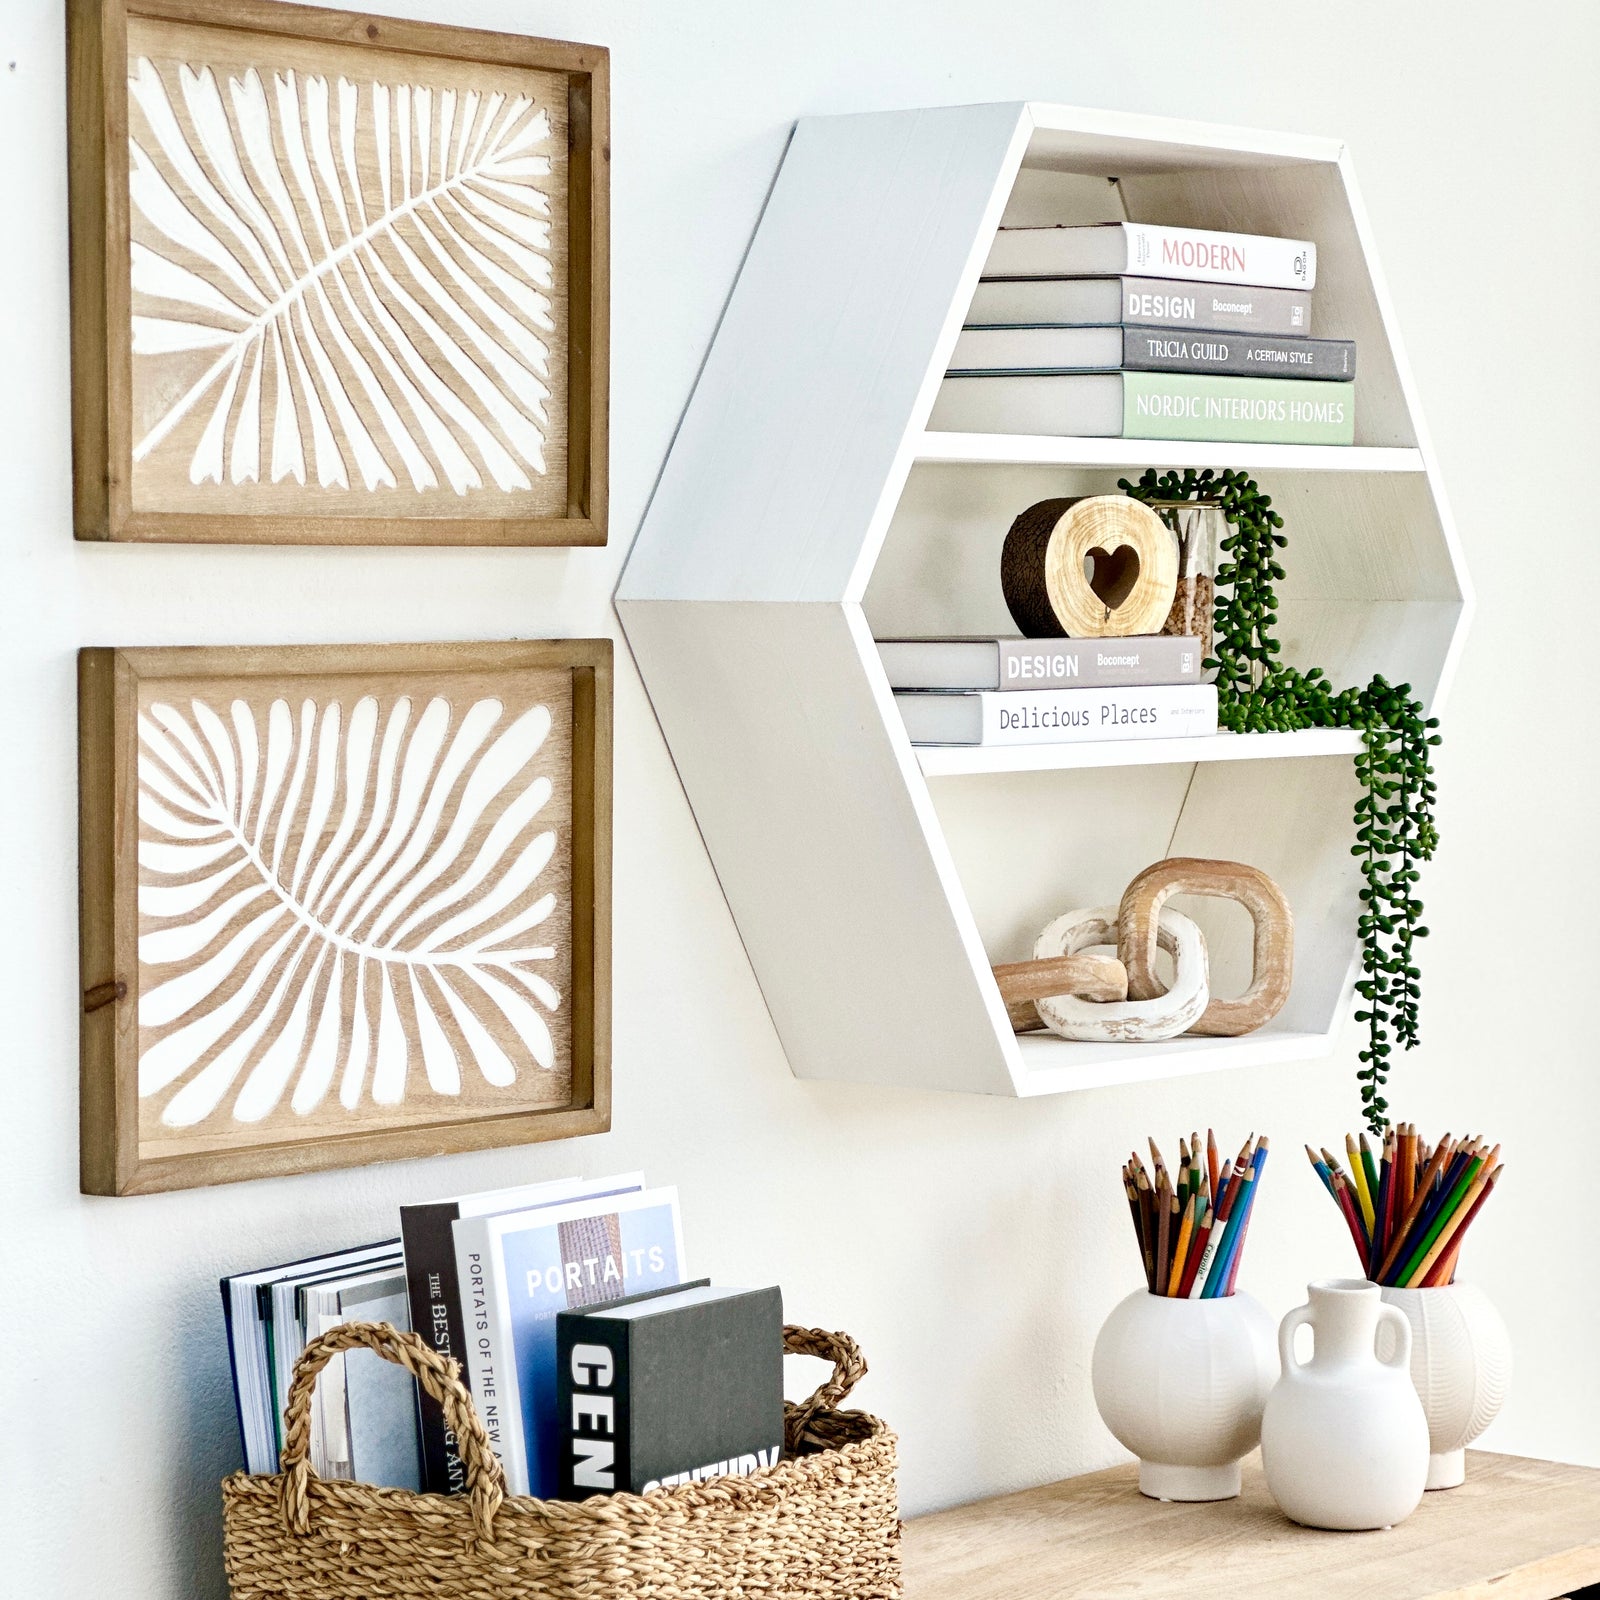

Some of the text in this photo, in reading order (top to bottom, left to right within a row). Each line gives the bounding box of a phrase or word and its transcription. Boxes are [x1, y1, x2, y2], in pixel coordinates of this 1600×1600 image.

[1162, 238, 1246, 272] MODERN
[1128, 294, 1253, 319] DESIGN Boconcept
[1147, 339, 1314, 364] TRICIA GUILD A CERTIAN STYLE
[1137, 394, 1344, 424] NORDIC INTERIORS HOMES
[1007, 655, 1079, 679] DESIGN
[1097, 653, 1140, 668] Boconcept
[1000, 706, 1090, 730] Delicious
[1100, 704, 1158, 726] Places
[428, 1272, 442, 1299] THE
[526, 1246, 666, 1299] PORTAITS
[468, 1253, 488, 1331] PORTATS
[478, 1338, 492, 1359] OF
[482, 1366, 496, 1399] THE
[486, 1405, 502, 1444] NEW
[571, 1343, 616, 1490] CEN
